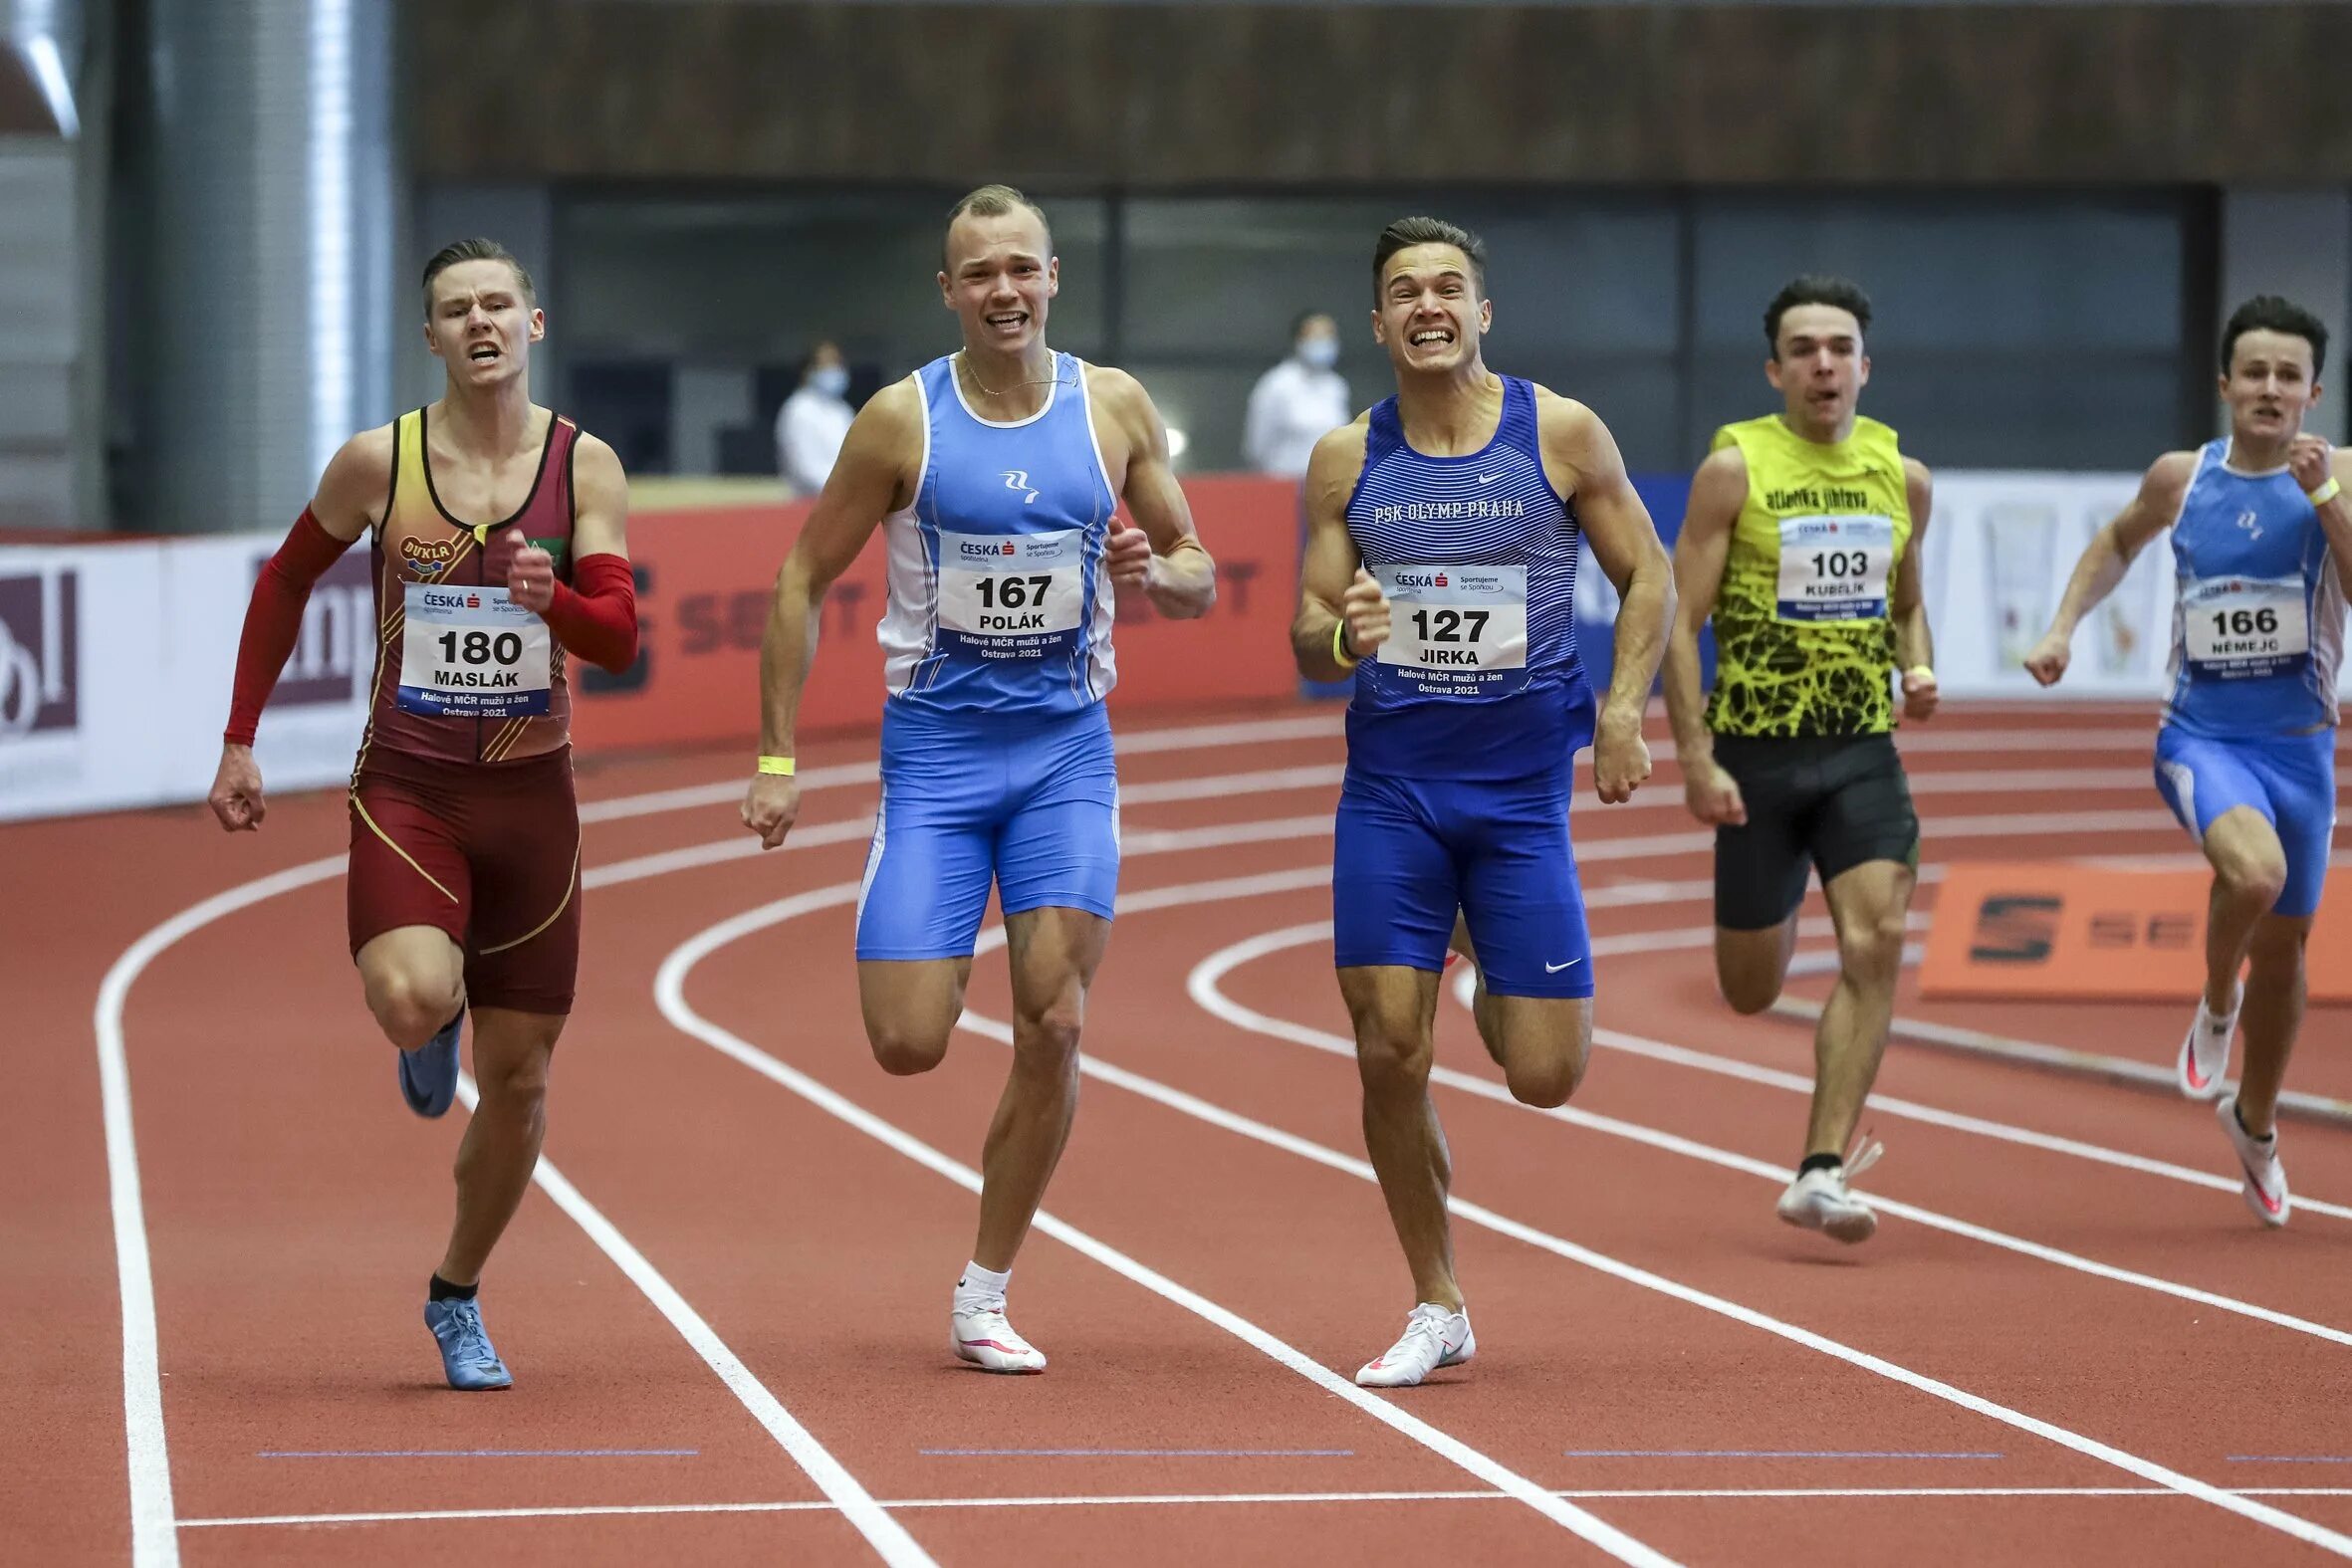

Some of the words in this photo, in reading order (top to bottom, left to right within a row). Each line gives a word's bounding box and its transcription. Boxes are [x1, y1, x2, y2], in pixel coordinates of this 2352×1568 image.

[1374, 505, 1403, 525] PSK
[1408, 502, 1462, 521] OLYMP
[1467, 500, 1525, 518] PRAHA
[403, 541, 450, 560] DUKLA
[961, 541, 1000, 556] ČESKÁ
[1811, 552, 1868, 578] 103
[1395, 571, 1433, 587] ČESKÁ
[424, 590, 465, 608] ČESKÁ
[976, 574, 1053, 609] 167
[979, 611, 1045, 629] POLÁK
[1412, 609, 1490, 643] 127
[2212, 607, 2278, 636] 166
[438, 630, 523, 665] 180
[960, 634, 989, 646] Halové
[991, 637, 1014, 647] MČR
[1016, 636, 1040, 646] mužů
[1049, 635, 1062, 644] žen
[981, 649, 1016, 658] Ostrava
[1419, 649, 1479, 665] JIRKA
[434, 670, 520, 687] MASLÁK
[1397, 668, 1426, 680] Halové
[1428, 671, 1450, 682] MČR
[1452, 673, 1476, 683] mužů
[1487, 672, 1504, 681] žen
[1418, 683, 1452, 694] Ostrava
[1454, 685, 1480, 695] 2021
[420, 691, 452, 704] Halové
[454, 694, 478, 705] MČR
[480, 695, 505, 706] mužů
[514, 694, 529, 704] žen
[442, 707, 480, 717] Ostrava
[482, 708, 507, 717] 2021
